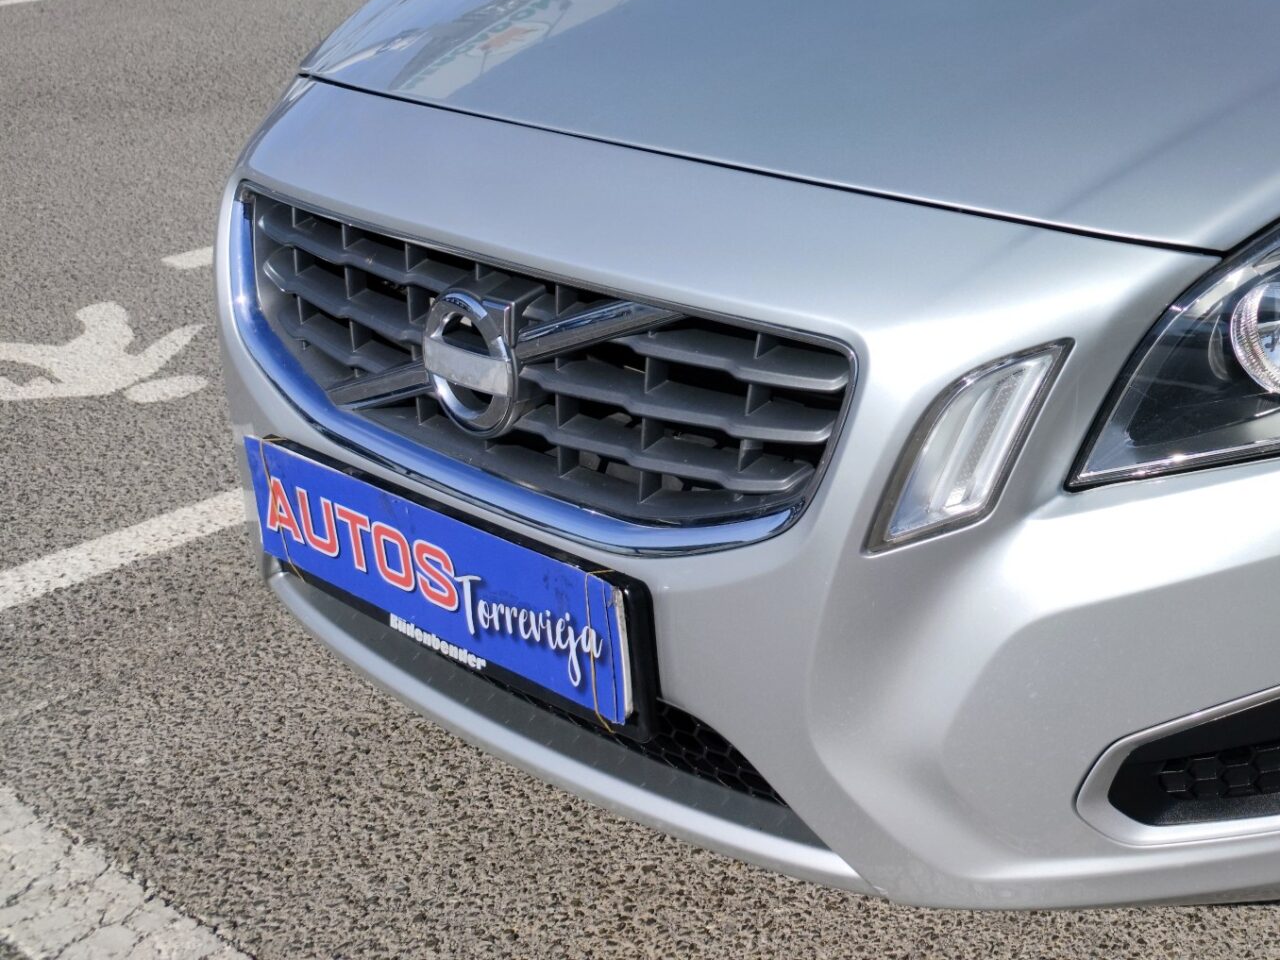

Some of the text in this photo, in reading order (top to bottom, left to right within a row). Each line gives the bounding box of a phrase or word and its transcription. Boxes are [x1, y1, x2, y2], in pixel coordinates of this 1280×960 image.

[267, 476, 604, 688] AUTOS Torrevieja
[389, 612, 488, 671] Büdenbender
